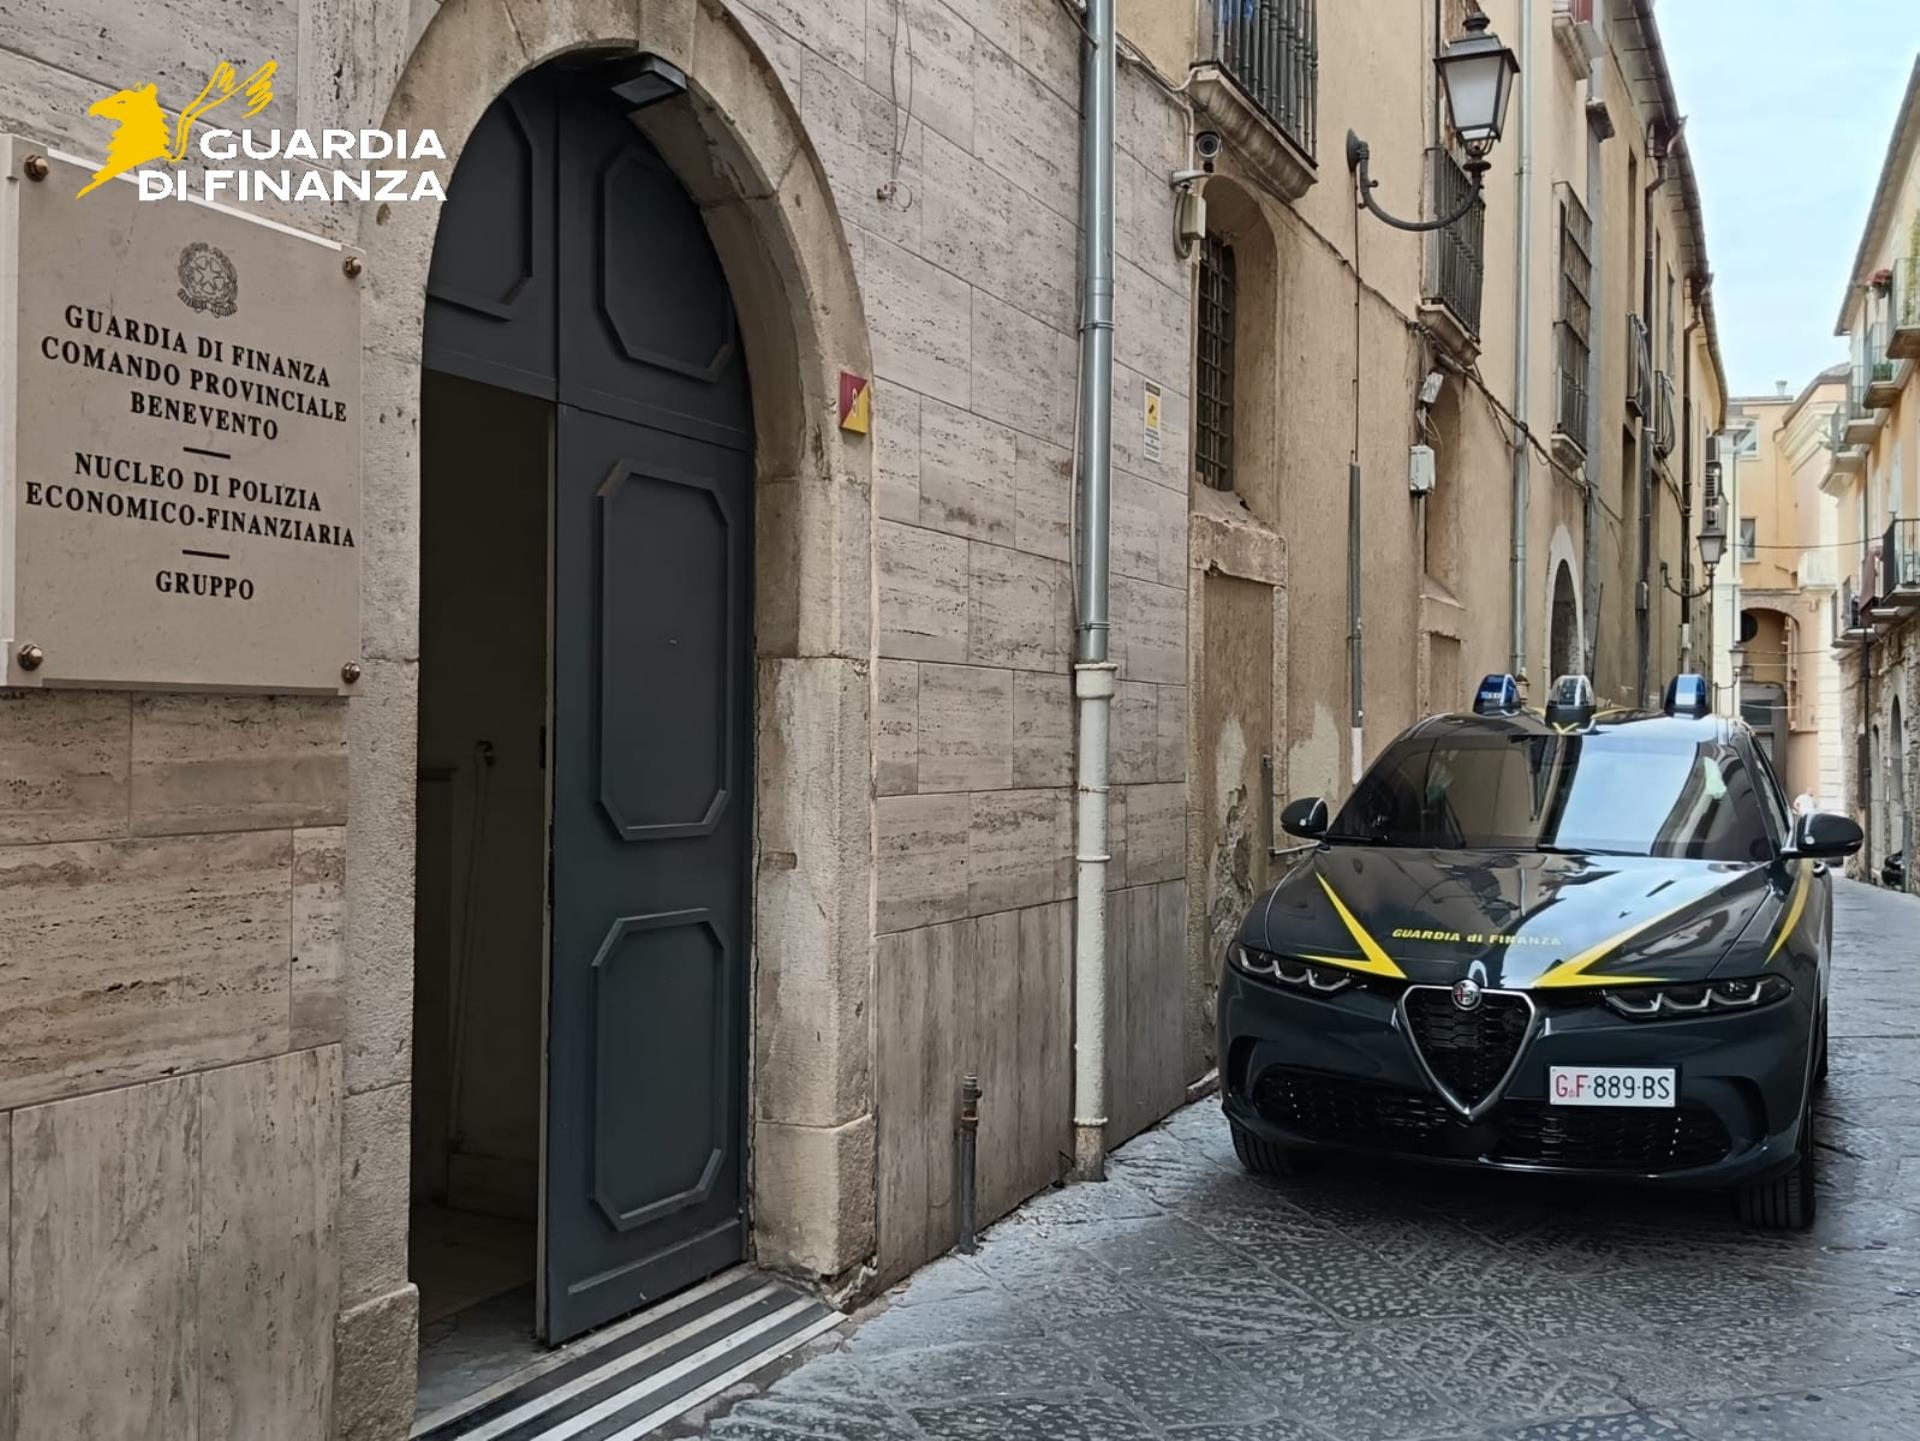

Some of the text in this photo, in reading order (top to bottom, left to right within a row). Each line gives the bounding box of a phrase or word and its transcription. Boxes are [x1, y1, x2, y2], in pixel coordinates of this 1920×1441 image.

[64, 304, 331, 388] GUARDIA DI FINANZA
[41, 336, 348, 422] COMANDO PROVINCIALE
[130, 391, 279, 441] BENEVENTO
[75, 452, 322, 512] NUCLEO DI POLIZIA
[25, 481, 356, 548] ECONOMICO-FINANZIARIA
[156, 570, 255, 601] GRUPPO
[1391, 928, 1563, 946] GUARDIA di FINANZA
